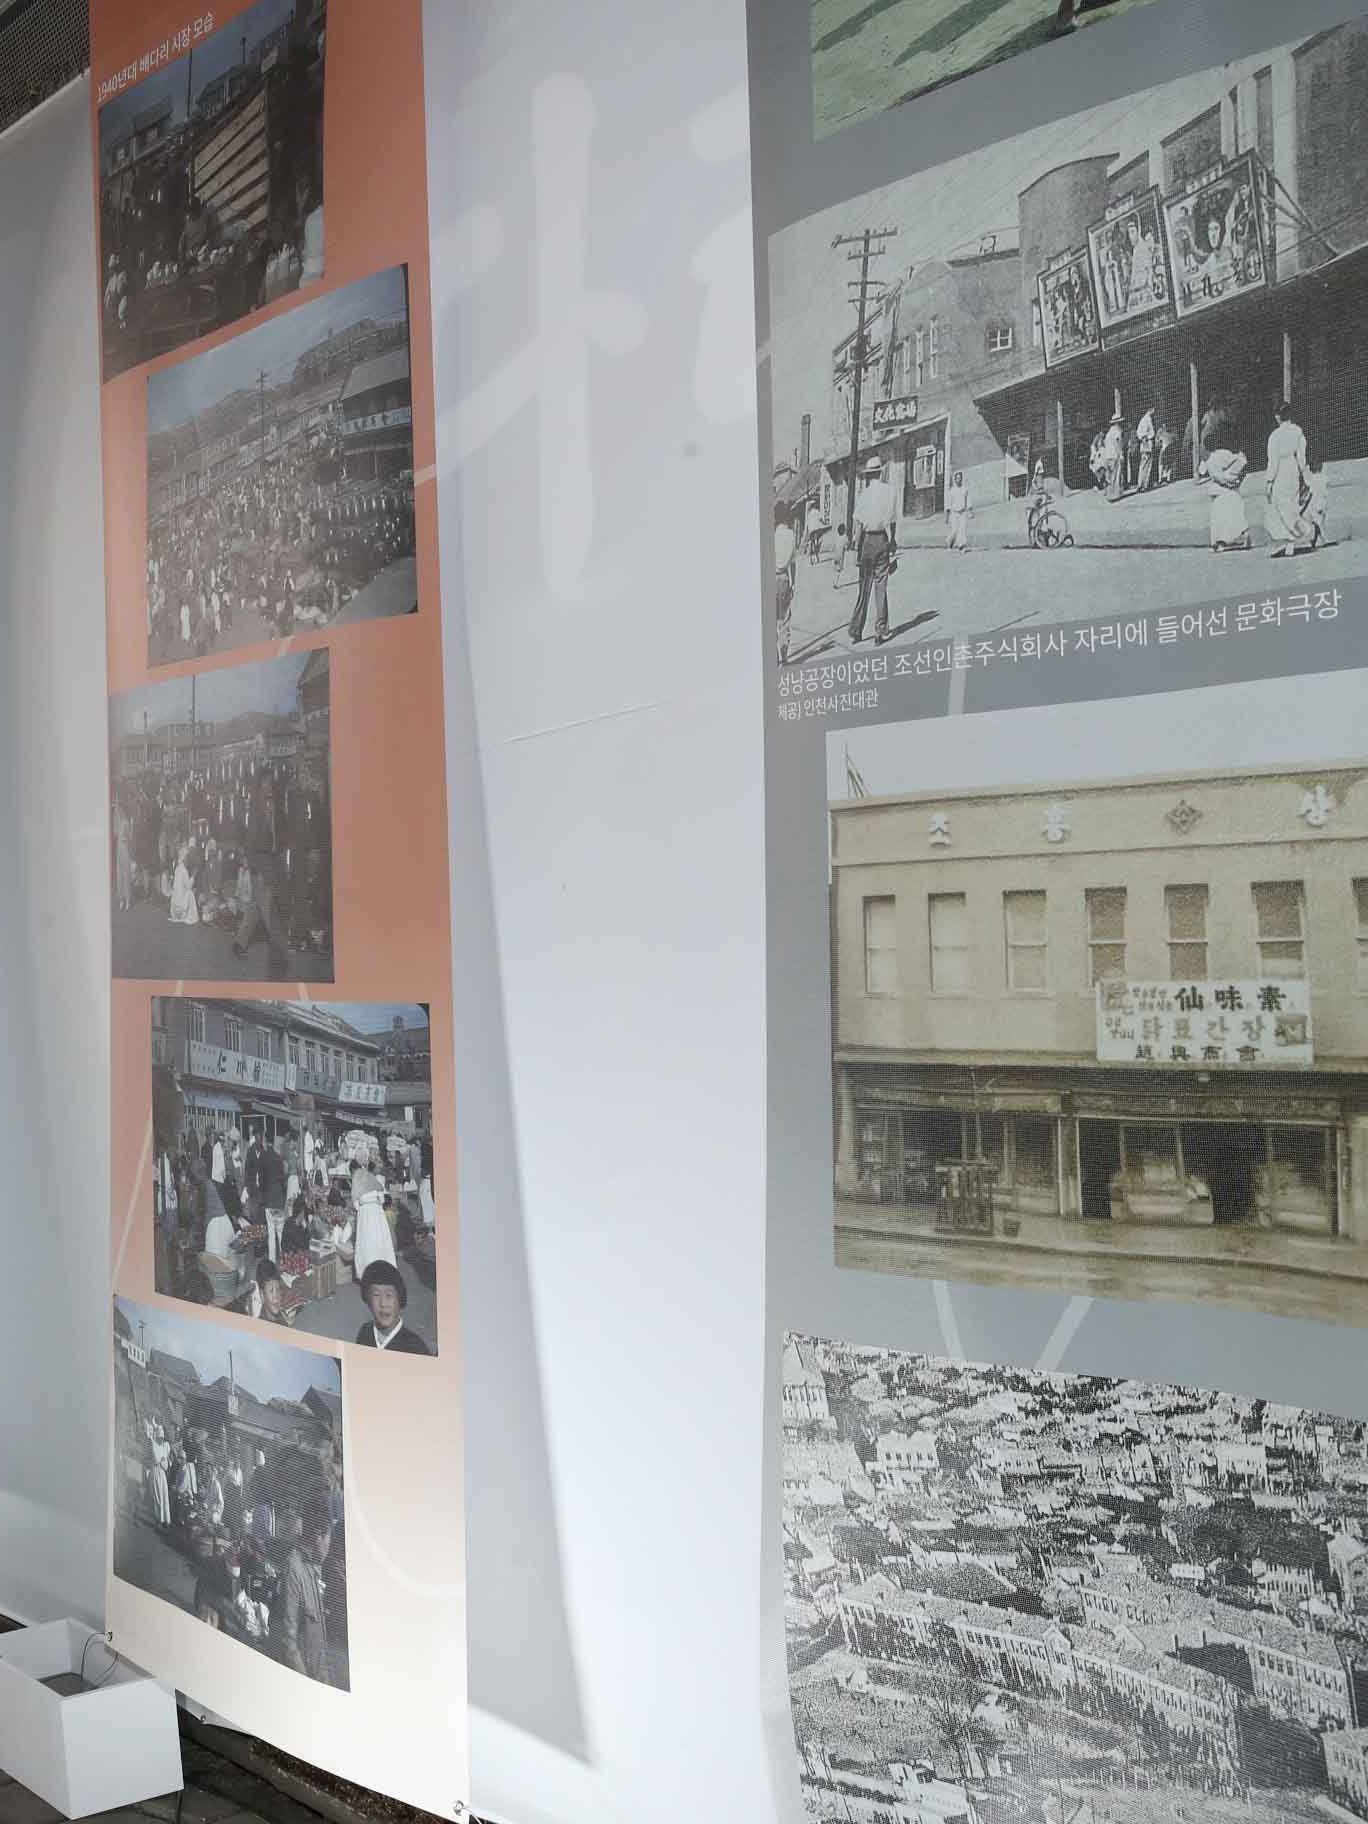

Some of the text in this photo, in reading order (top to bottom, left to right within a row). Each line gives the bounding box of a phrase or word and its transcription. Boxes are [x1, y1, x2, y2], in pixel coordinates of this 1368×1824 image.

[97, 11, 214, 104] 1940년대 배다리 시장 모습
[778, 588, 1342, 697] 성냥공장이었던 조선인촌주식회사 자리에 들어선 문화극장
[803, 688, 880, 717] 인천사진대관
